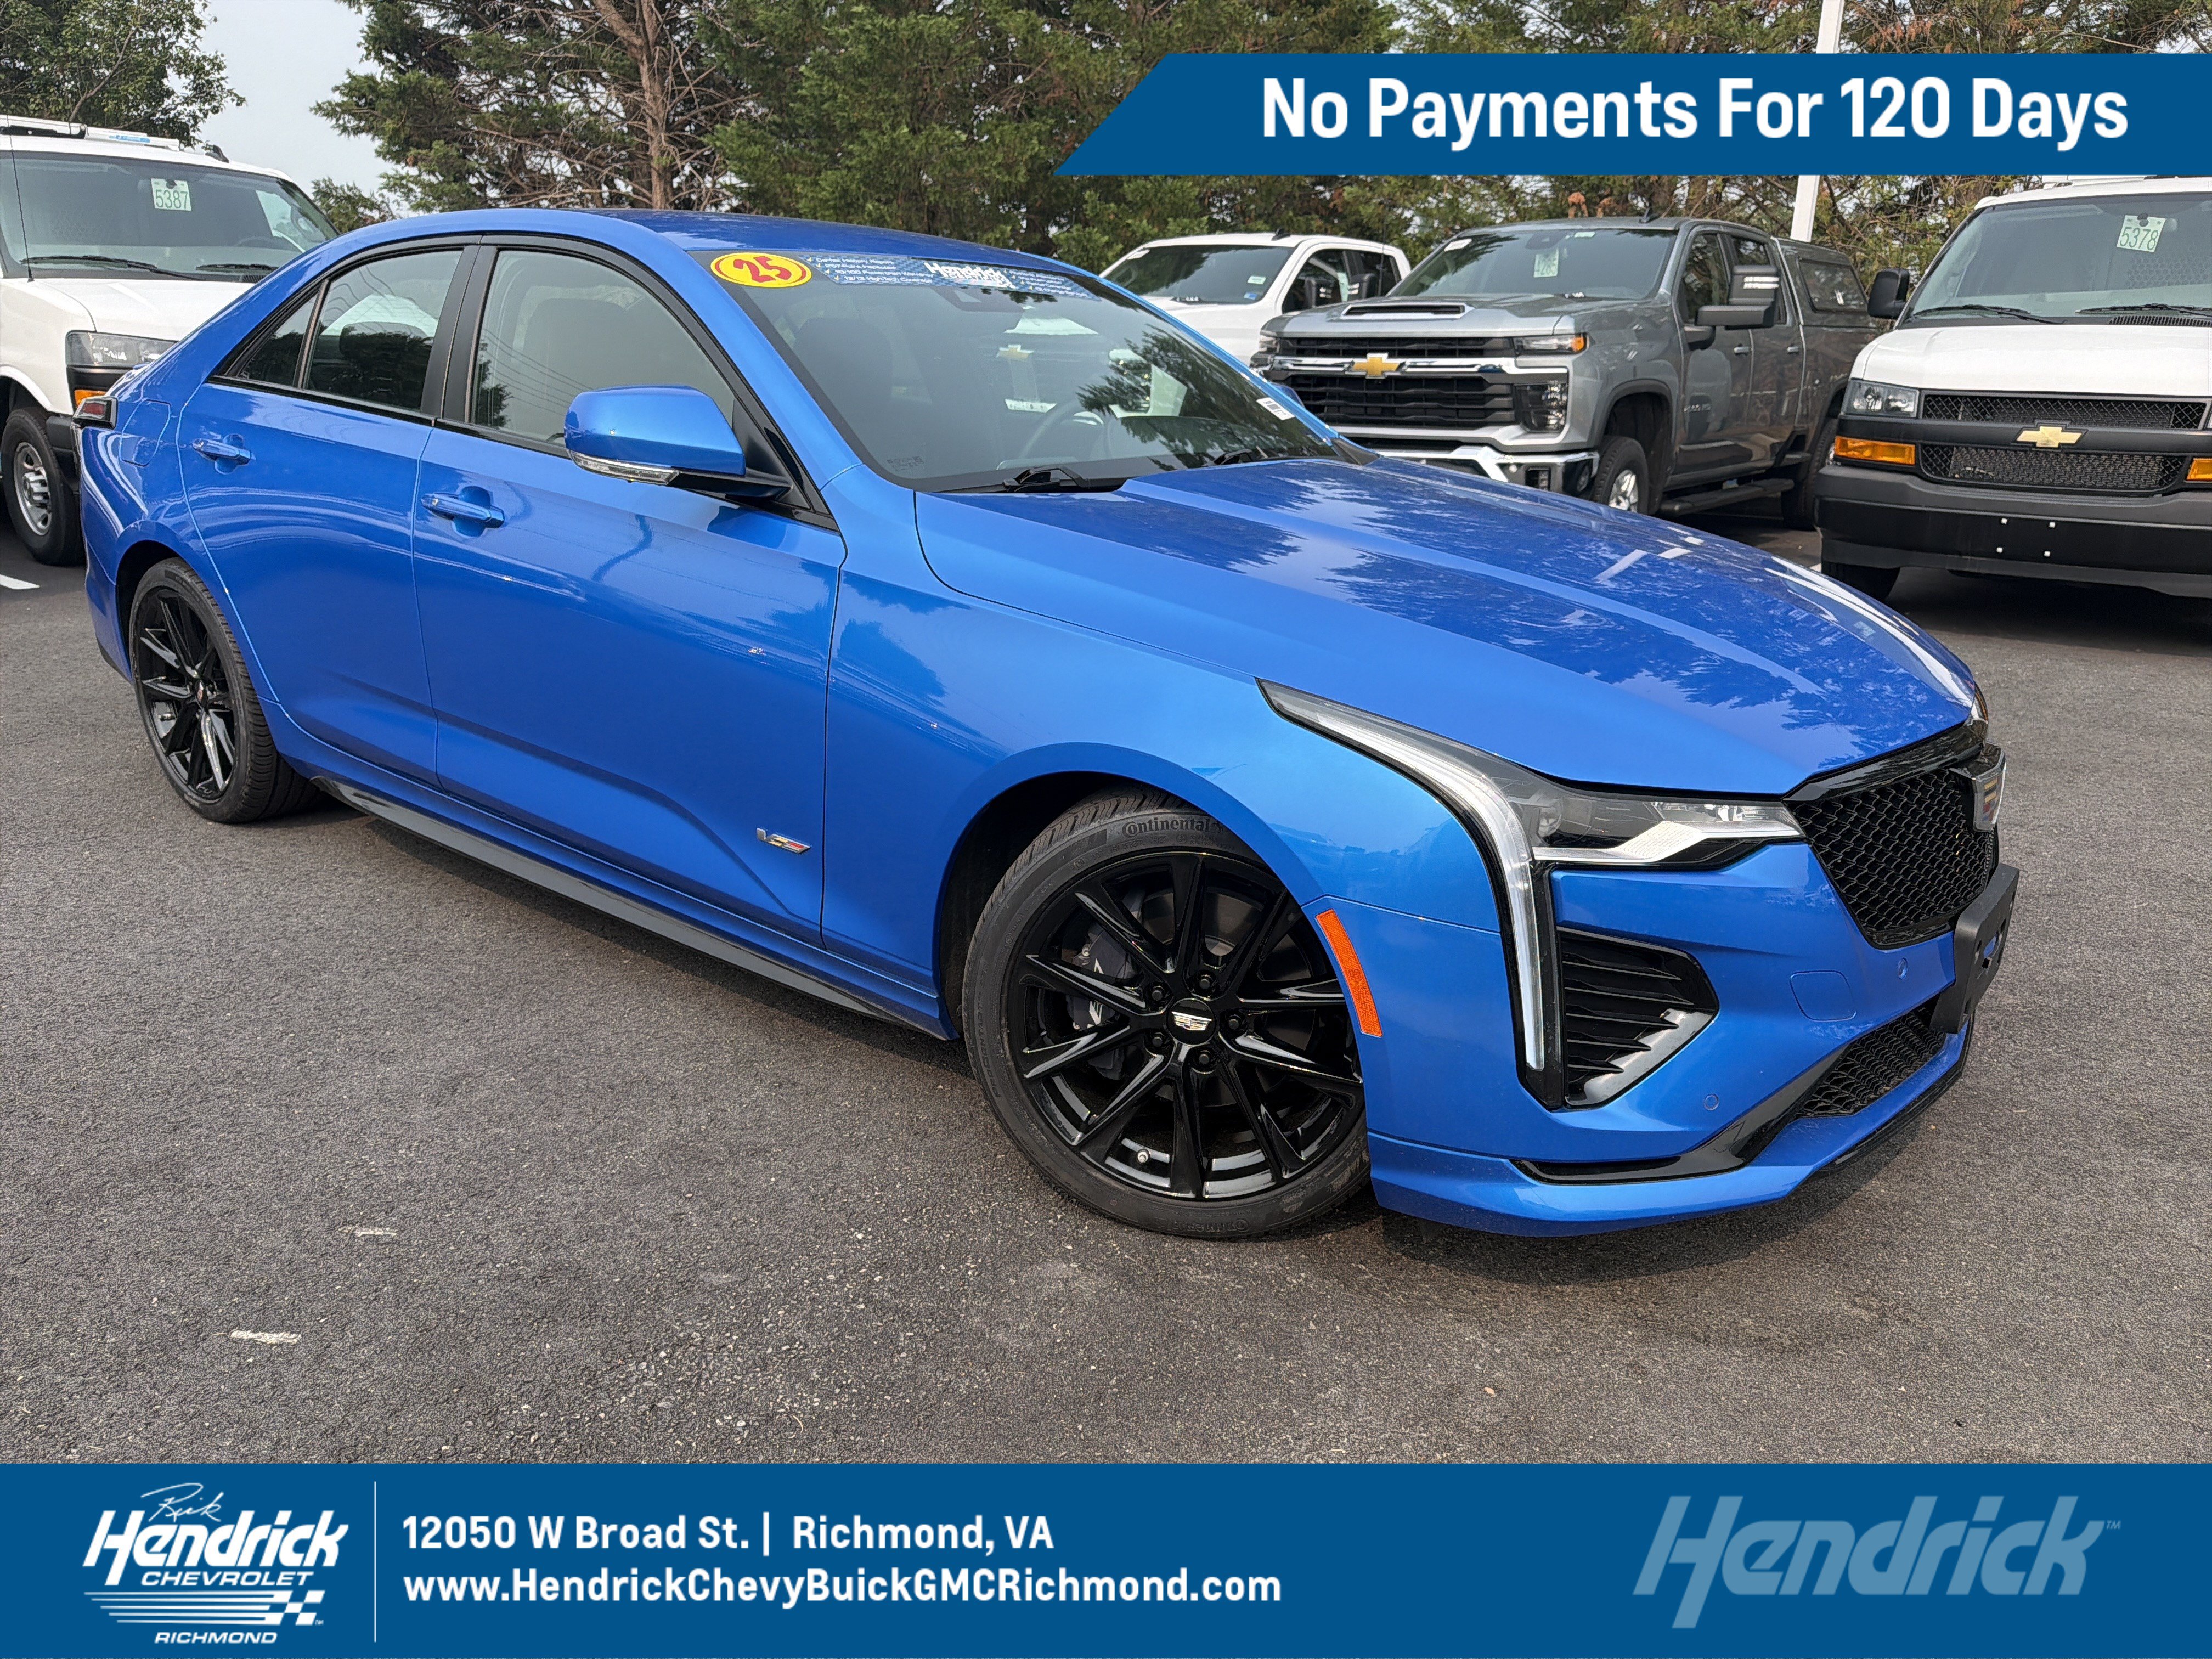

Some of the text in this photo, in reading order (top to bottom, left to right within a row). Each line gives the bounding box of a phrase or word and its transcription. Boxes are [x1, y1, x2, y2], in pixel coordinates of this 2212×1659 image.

[155, 189, 188, 209] 5387
[2119, 226, 2159, 251] 5378
[733, 256, 792, 283] 25
[923, 262, 1008, 281] Hendrick
[1121, 817, 1211, 838] Continental
